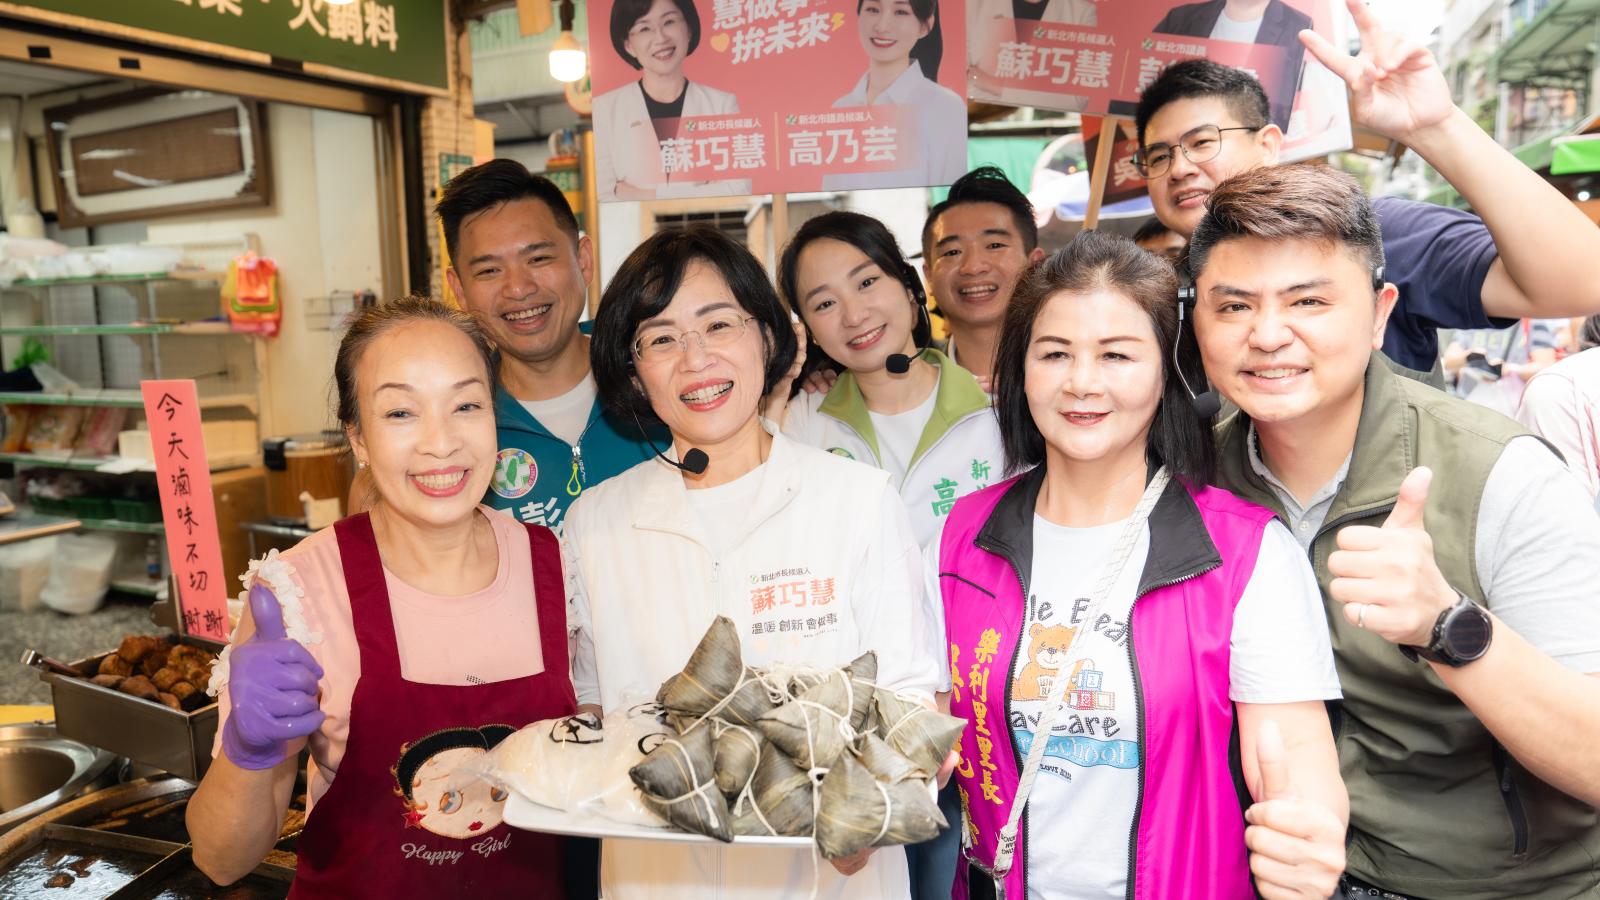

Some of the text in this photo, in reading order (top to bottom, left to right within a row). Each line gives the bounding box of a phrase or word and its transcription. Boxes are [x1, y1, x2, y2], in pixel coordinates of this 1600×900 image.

[994, 41, 1113, 88] 蘇巧慧
[698, 117, 762, 131] 新北市長候選人
[660, 133, 767, 173] 蘇巧慧
[787, 126, 897, 167] 高乃芸
[751, 577, 836, 615] 蘇巧慧
[401, 833, 511, 866] Happy Girl
